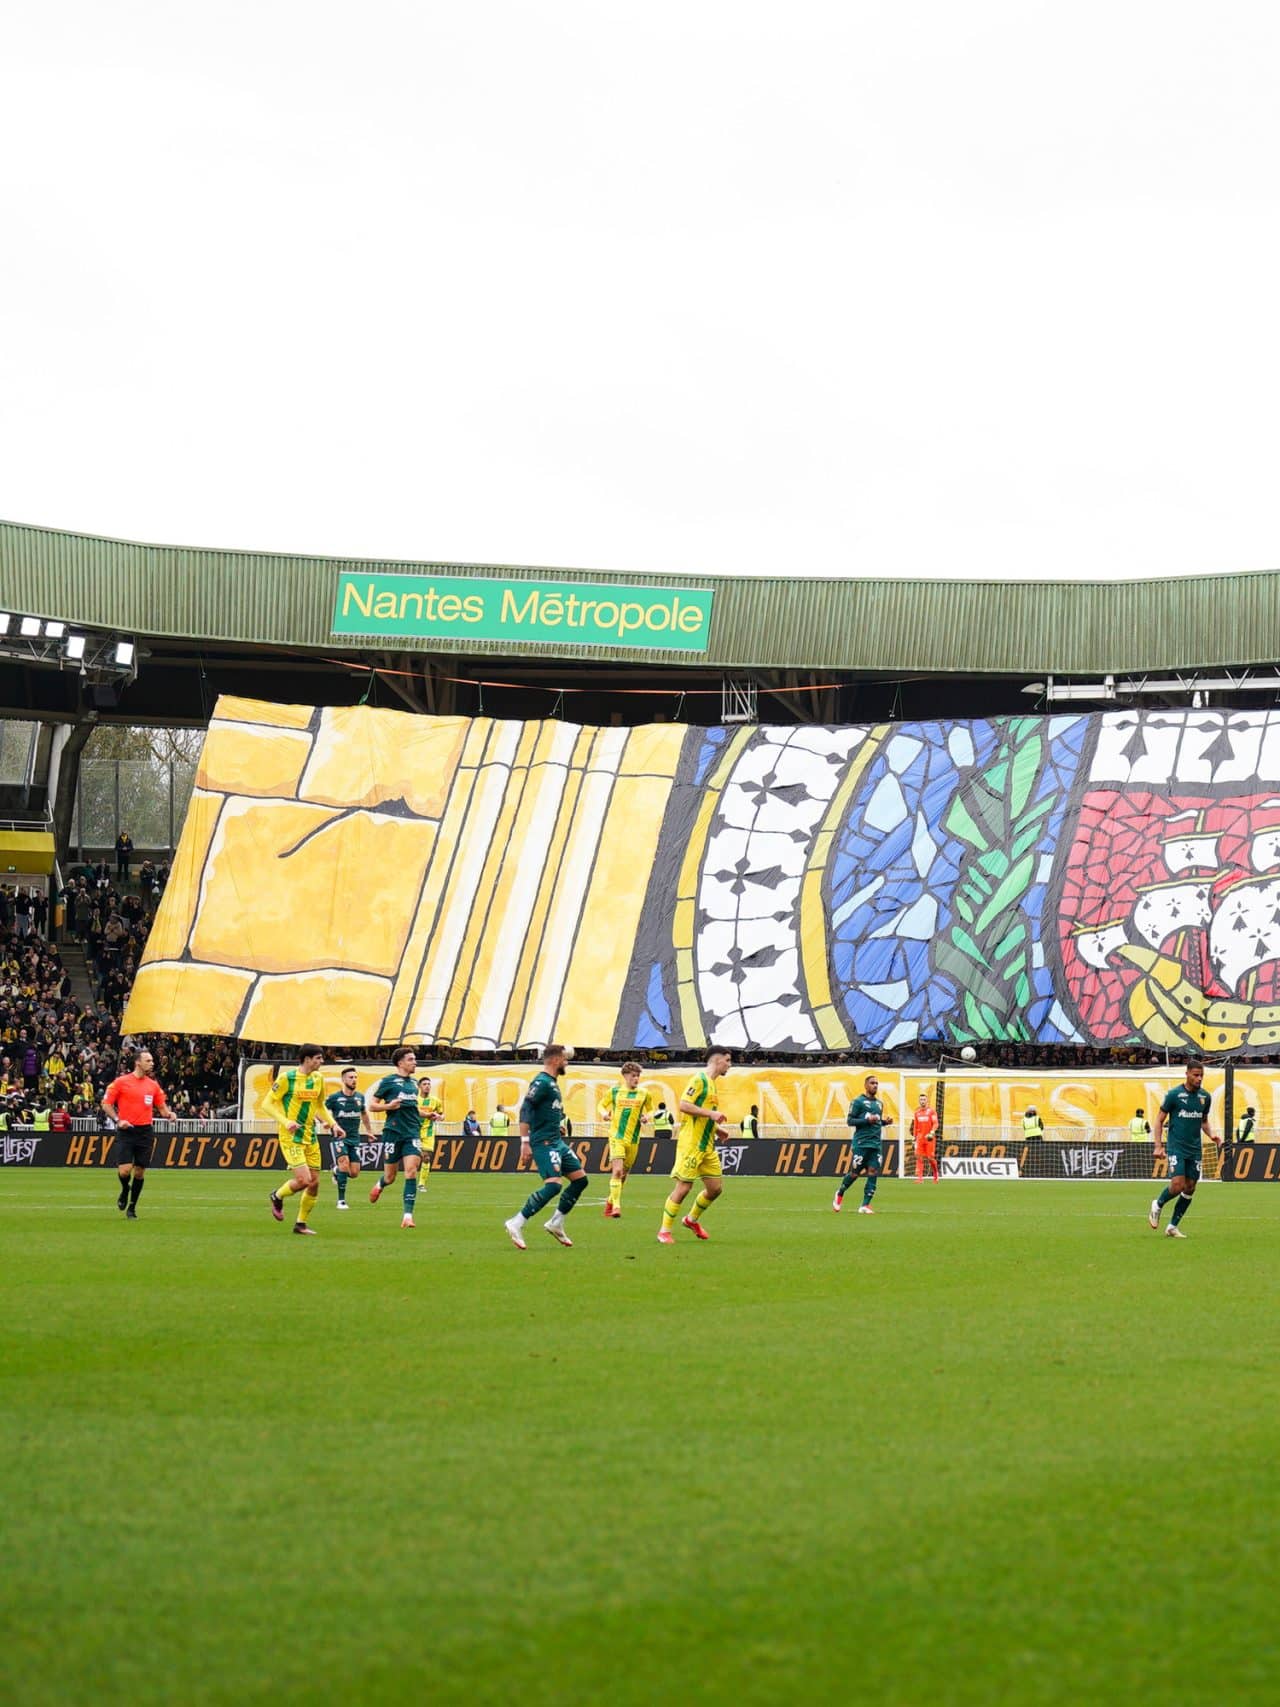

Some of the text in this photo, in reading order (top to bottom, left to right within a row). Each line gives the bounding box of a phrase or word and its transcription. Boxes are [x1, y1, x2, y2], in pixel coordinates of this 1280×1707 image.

[342, 583, 484, 622] Nantes
[66, 1135, 116, 1165] HEY
[165, 1137, 279, 1168] LET'S GO
[384, 1142, 395, 1154] 23
[432, 1140, 464, 1171] EY
[471, 1141, 509, 1172] HO
[775, 1144, 828, 1174] HEY
[1061, 1146, 1125, 1177] HELLFEST
[942, 1160, 1016, 1176] MILLET
